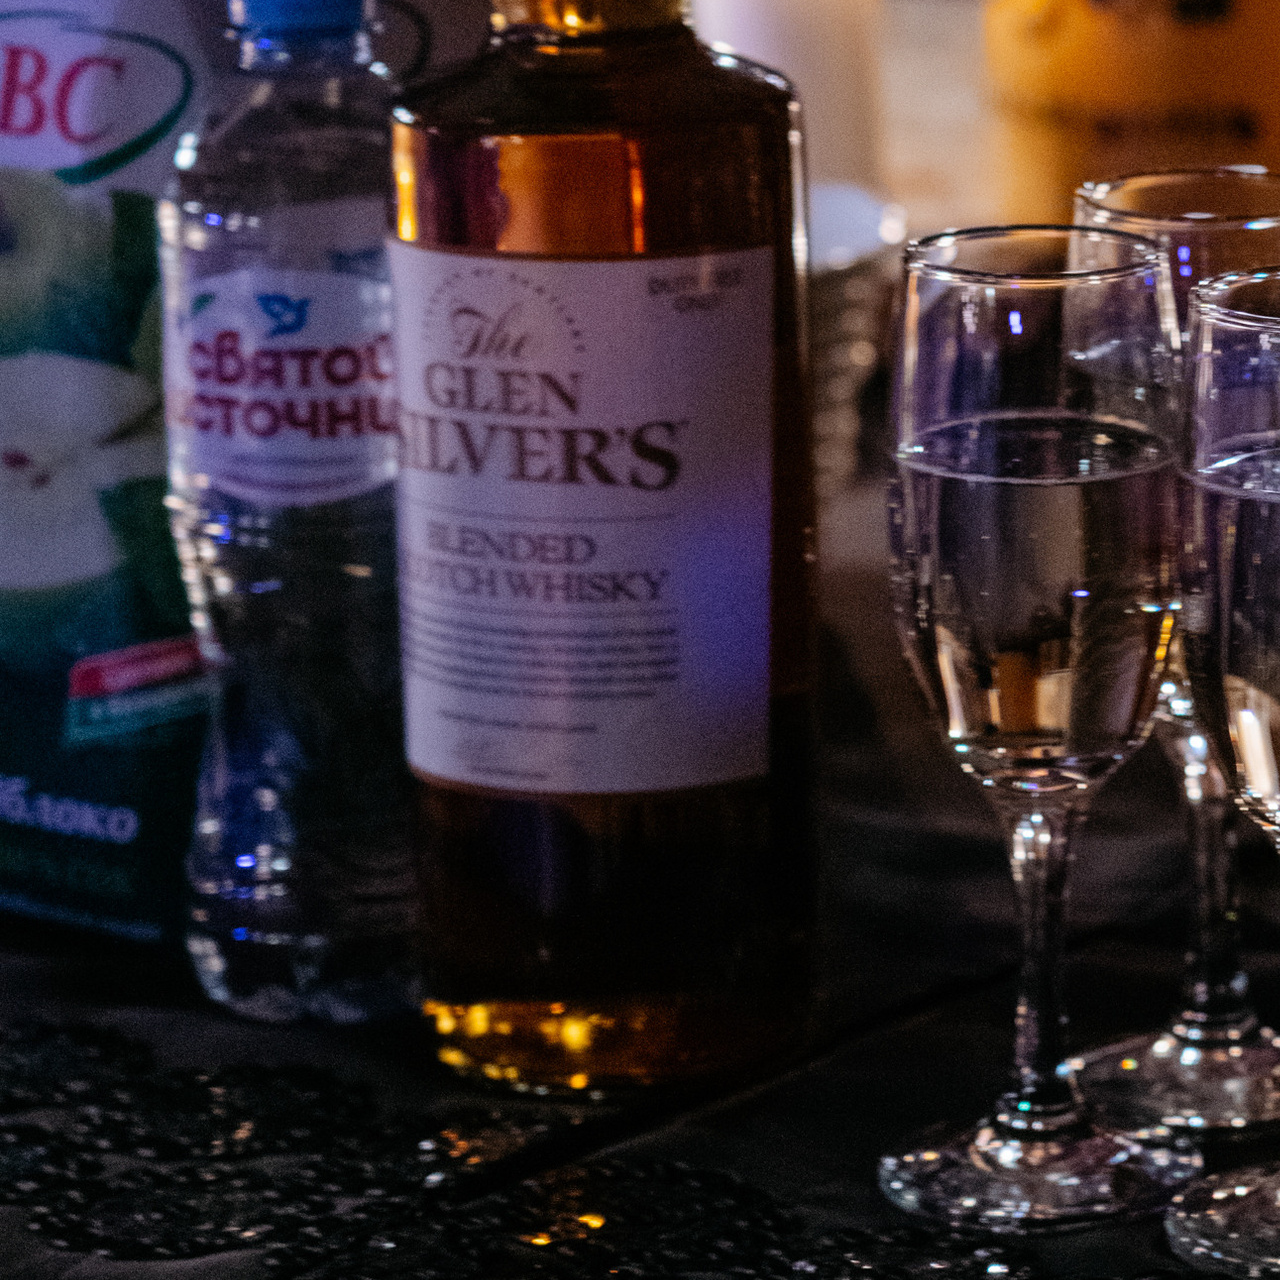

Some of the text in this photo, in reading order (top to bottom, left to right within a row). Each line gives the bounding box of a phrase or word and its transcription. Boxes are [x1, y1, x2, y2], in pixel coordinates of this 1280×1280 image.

[448, 298, 533, 358] The
[424, 362, 582, 415] GLEN
[428, 524, 598, 565] BLENDED
[504, 568, 670, 603] WHISKY
